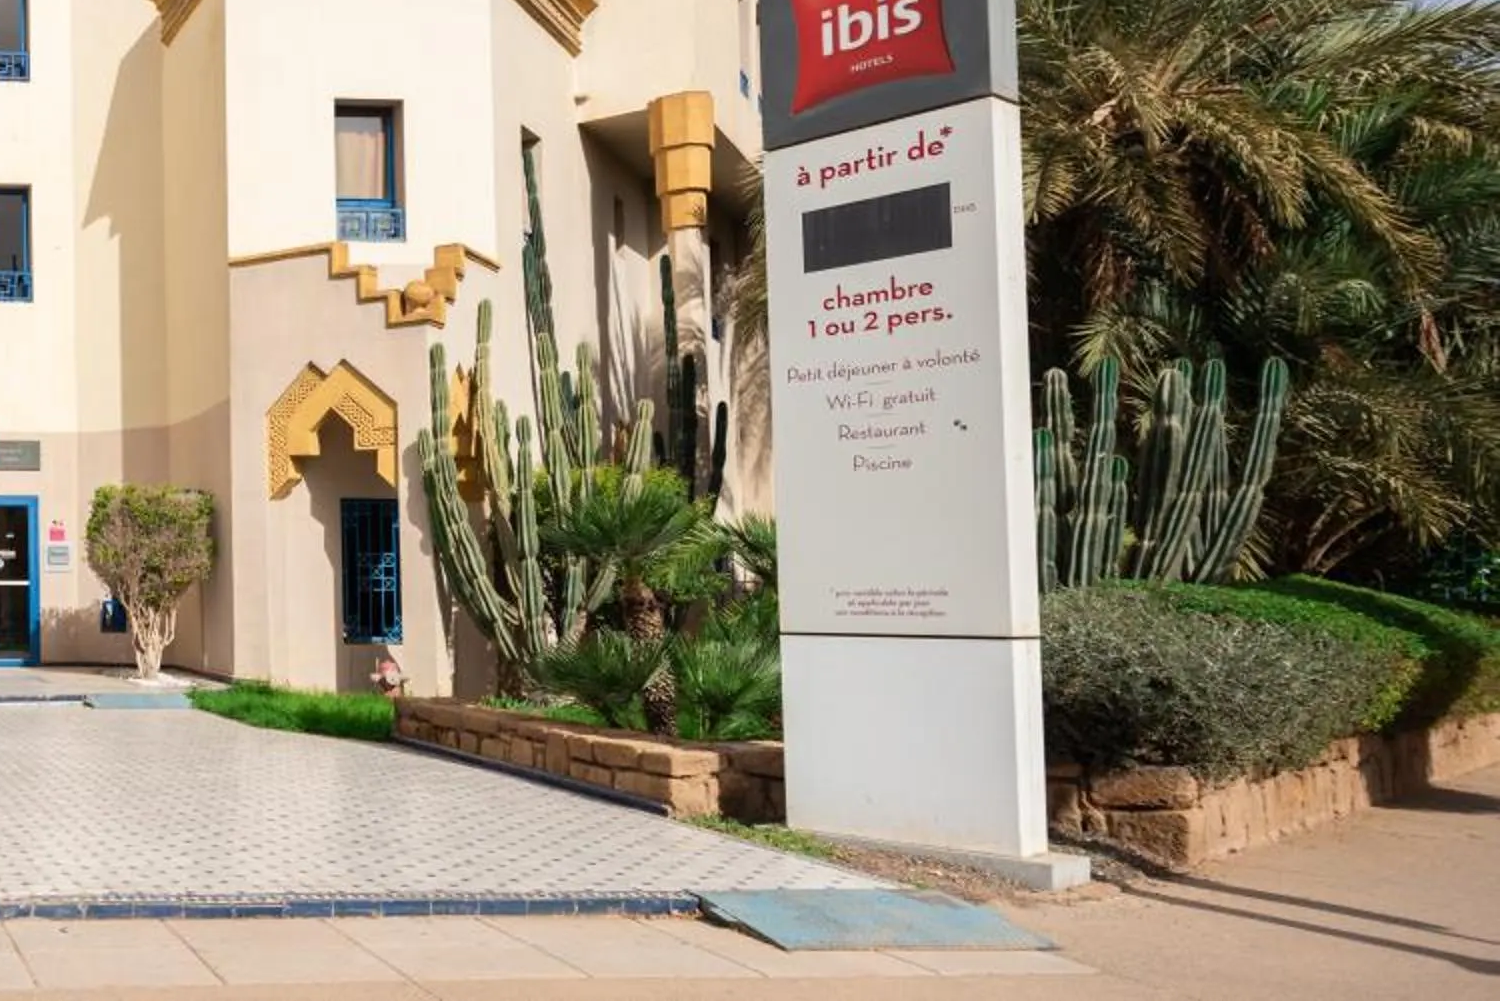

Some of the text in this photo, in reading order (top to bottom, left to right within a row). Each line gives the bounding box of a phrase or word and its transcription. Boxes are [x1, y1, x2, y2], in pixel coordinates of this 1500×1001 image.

[851, 54, 894, 73] HOTELS
[797, 166, 810, 186] à
[820, 146, 897, 188] partir
[823, 275, 933, 311] chambre
[808, 307, 953, 338] 1 ou 2 pers.
[787, 349, 981, 384] Petit déjeuner à volonté
[827, 387, 937, 410] Wi-Fi gratuit
[838, 422, 926, 441] Restaurant
[853, 454, 913, 472] Piscine
